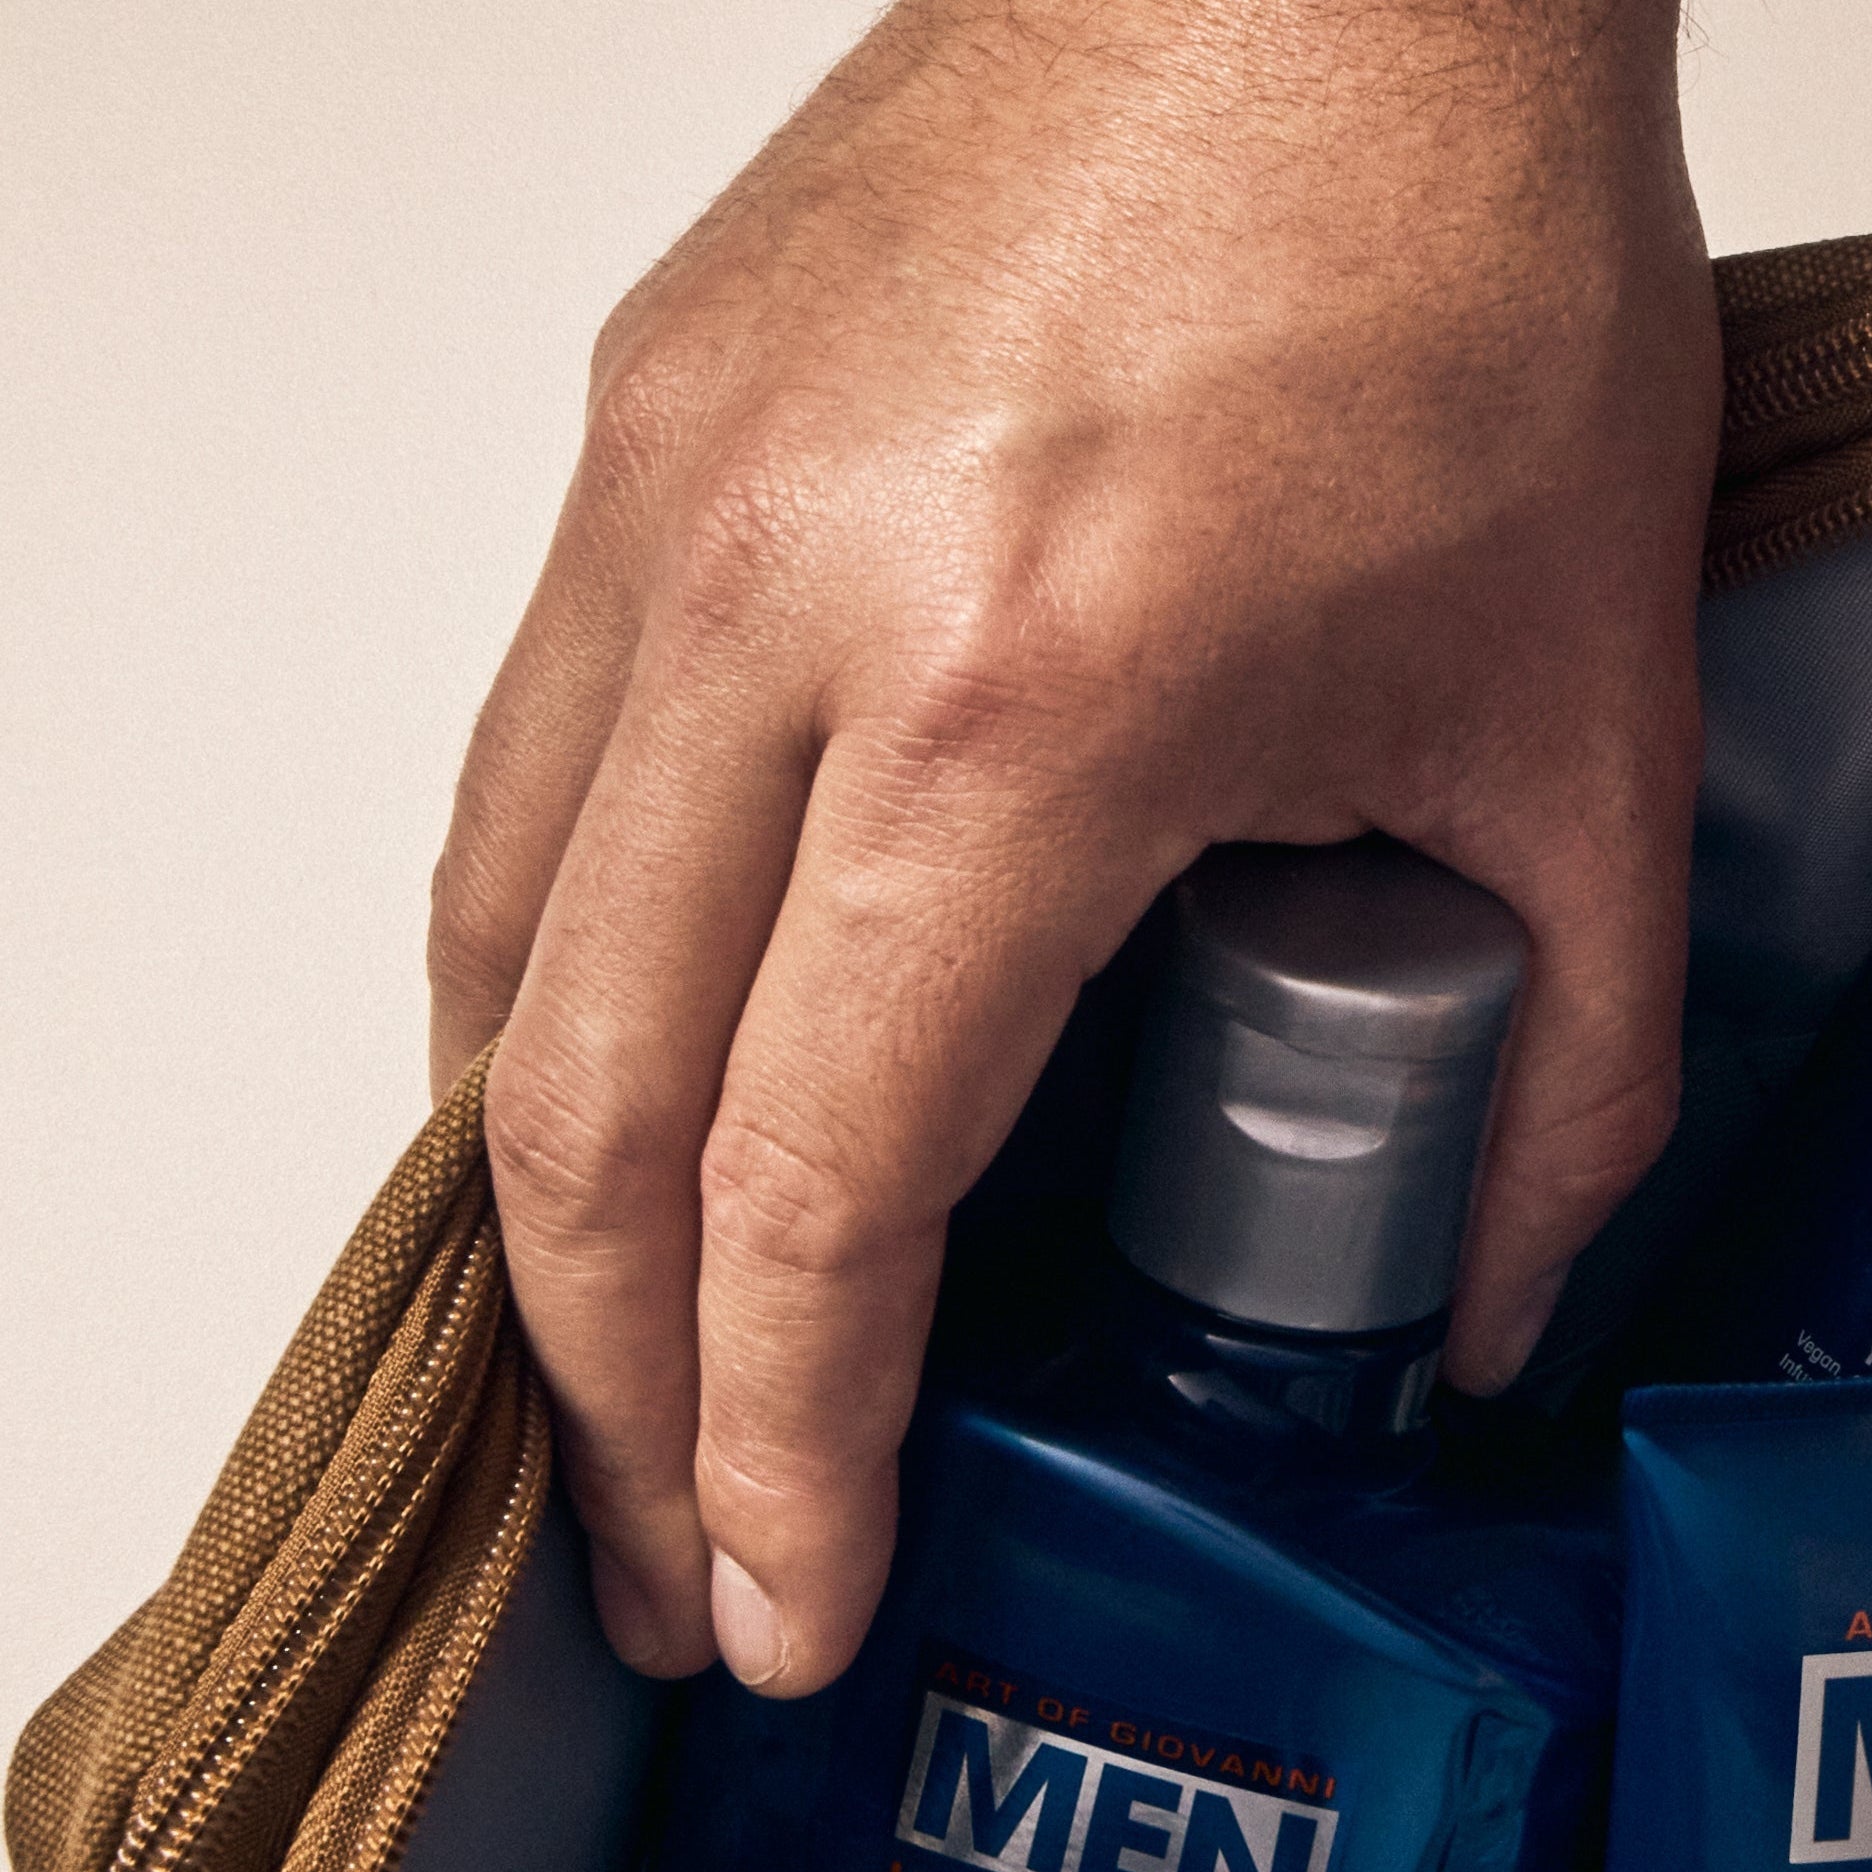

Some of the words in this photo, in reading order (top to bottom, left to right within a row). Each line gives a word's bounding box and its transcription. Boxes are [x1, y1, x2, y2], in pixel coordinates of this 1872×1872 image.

[935, 1662, 1018, 1704] ART
[1037, 1697, 1089, 1727] OF
[1110, 1721, 1335, 1798] GIOVANNI
